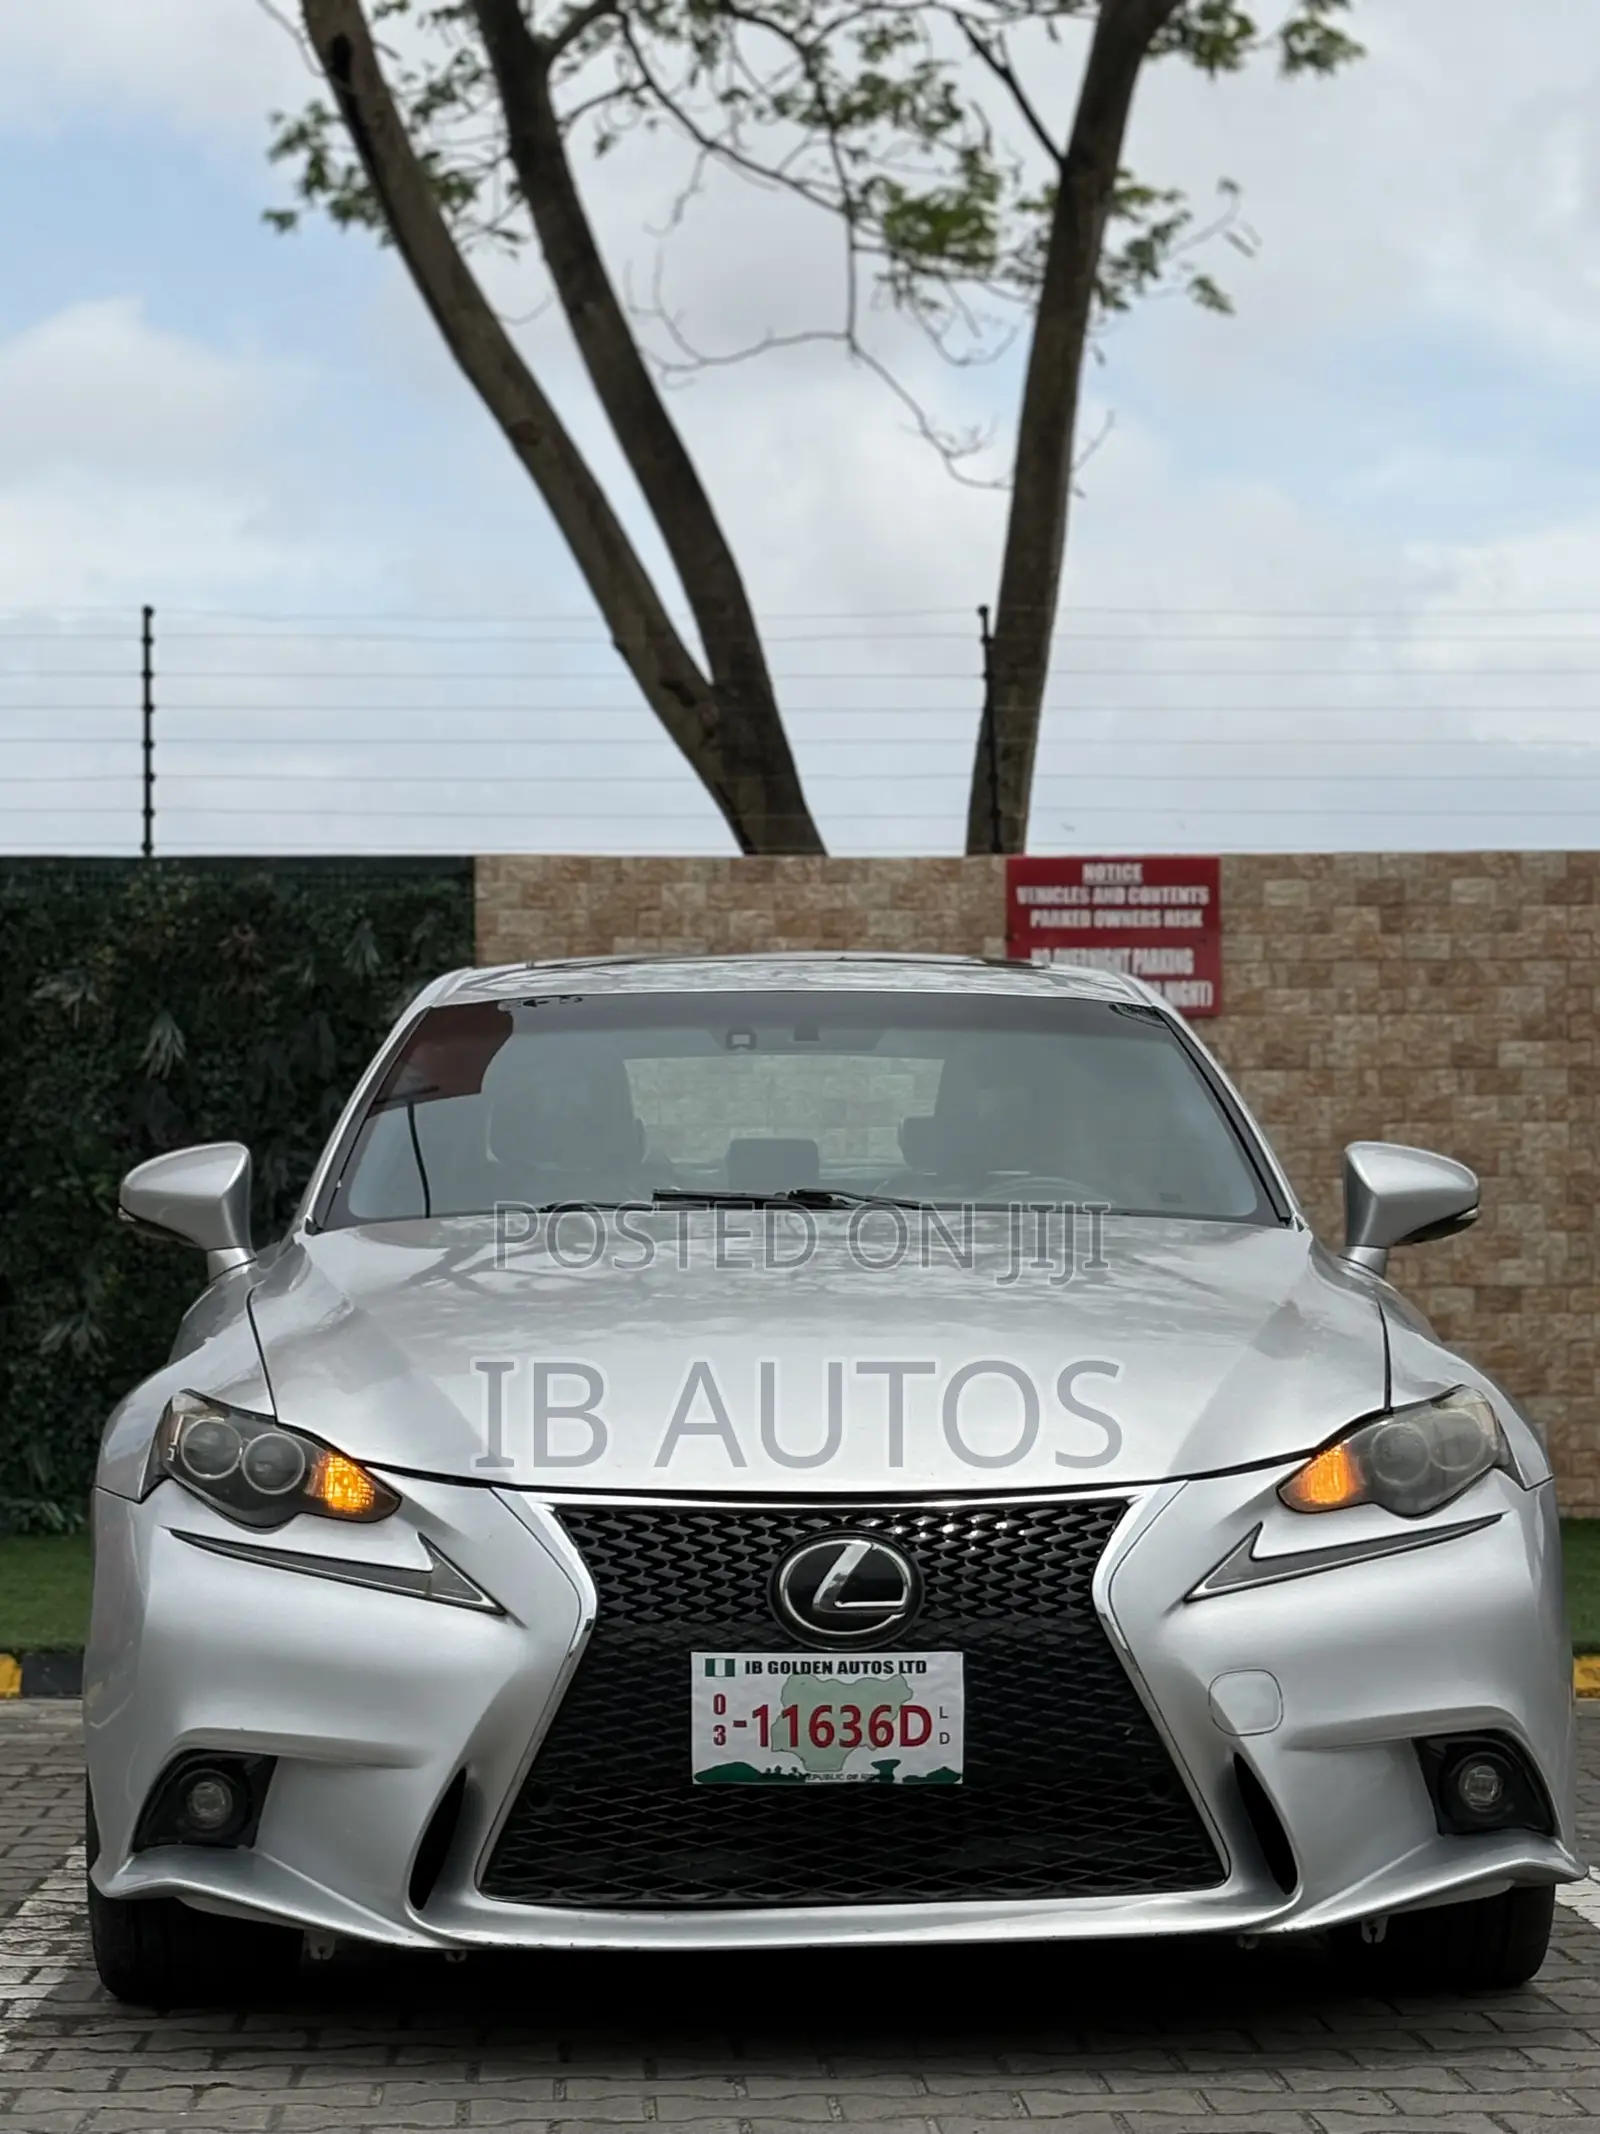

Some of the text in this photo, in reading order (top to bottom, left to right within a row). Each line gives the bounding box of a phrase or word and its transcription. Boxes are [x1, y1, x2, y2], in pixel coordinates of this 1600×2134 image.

[1082, 863, 1143, 884] NOTICE
[1016, 886, 1210, 905] VEHICLES AND CONTENTS
[1030, 909, 1203, 928] PARKED OWNERS RISK
[1132, 948, 1194, 976] PARKING
[745, 1660, 927, 1675] IB GOLDEN AUTOS LTD
[804, 1773, 845, 1781] EPUBLIC
